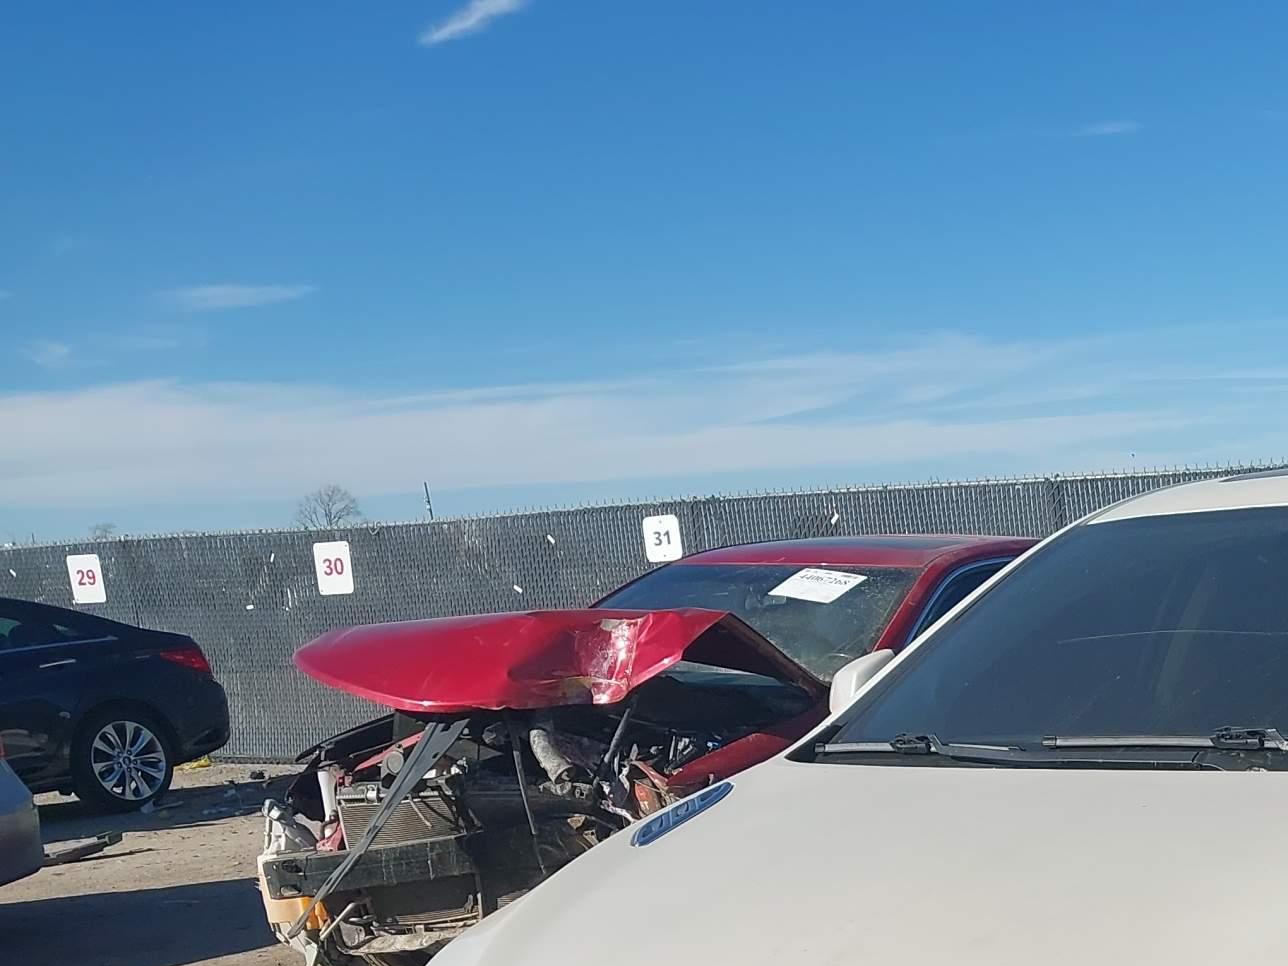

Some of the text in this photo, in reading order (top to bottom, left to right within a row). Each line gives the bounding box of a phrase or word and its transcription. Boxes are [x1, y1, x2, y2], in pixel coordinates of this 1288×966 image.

[653, 530, 671, 546] 31
[323, 557, 344, 576] 30
[76, 569, 96, 586] 29
